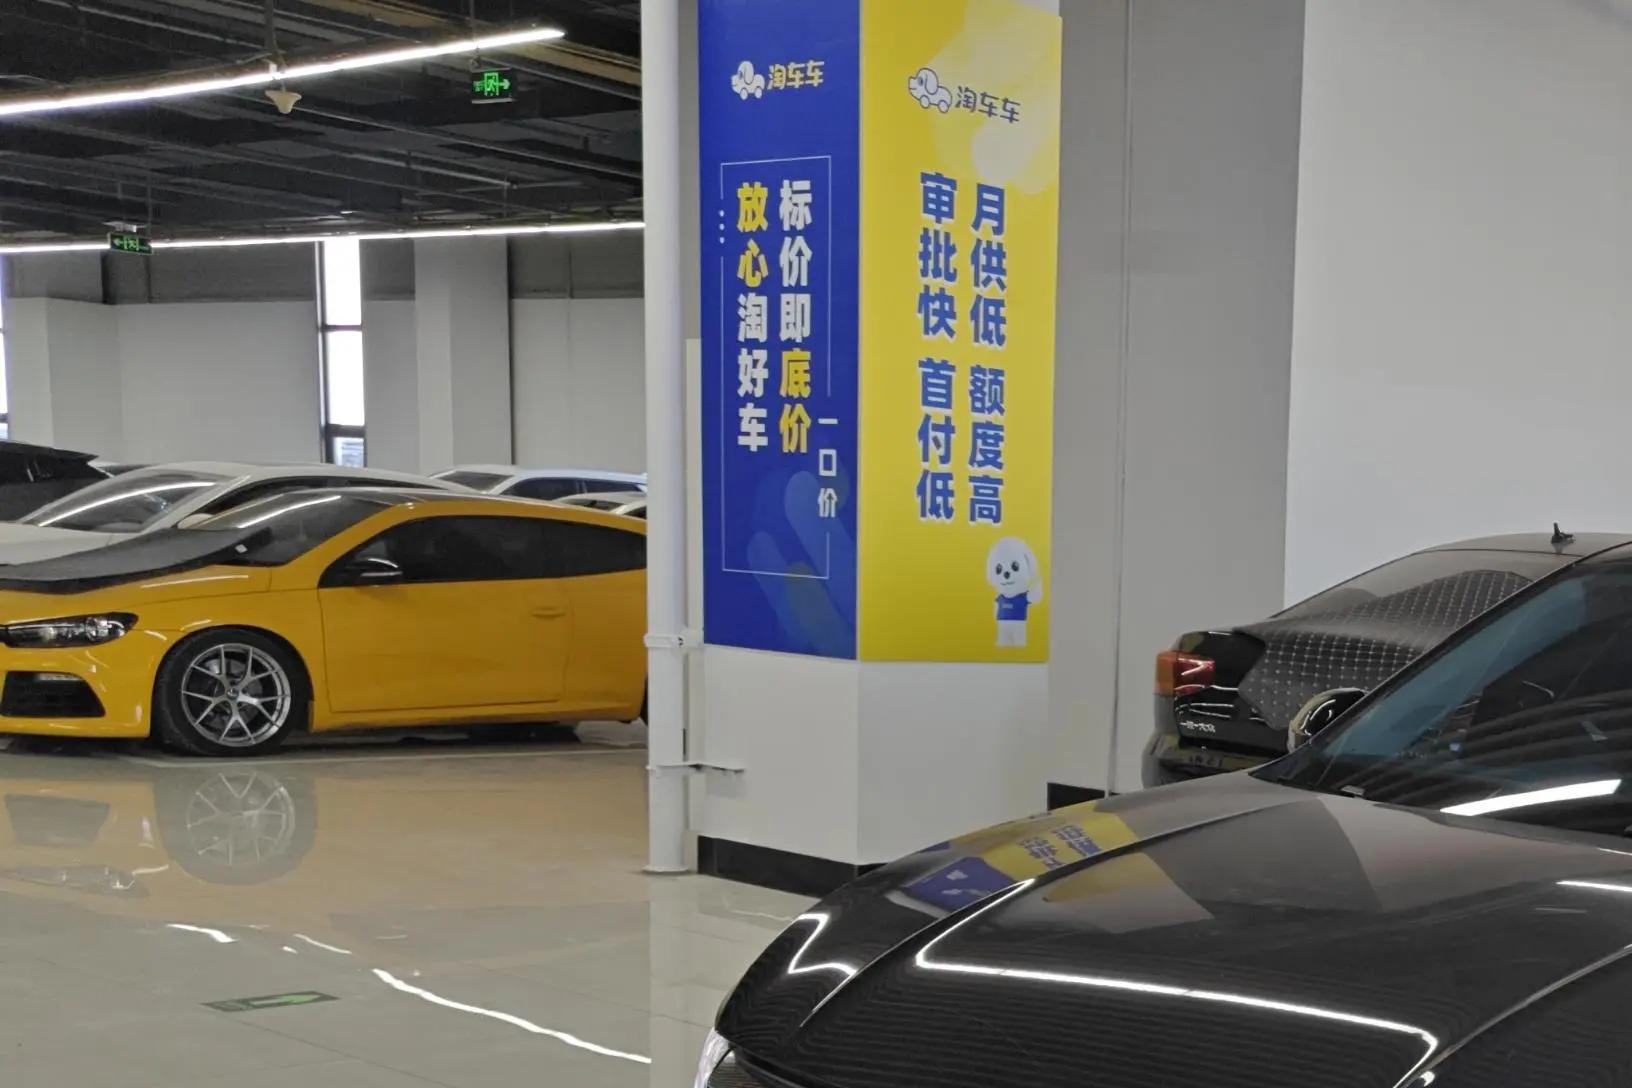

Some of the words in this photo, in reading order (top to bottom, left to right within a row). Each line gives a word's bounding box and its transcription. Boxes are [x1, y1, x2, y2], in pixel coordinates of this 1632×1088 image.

[768, 60, 824, 90] 淘车车
[955, 87, 1020, 123] 淘车车
[737, 182, 768, 451] 放心淘好车
[779, 180, 812, 453] 标价即底价
[916, 171, 958, 339] 审批快
[969, 183, 1008, 348] 月供低
[818, 418, 838, 518] 一口价
[915, 357, 957, 521] 首付低
[968, 365, 1006, 525] 额度高
